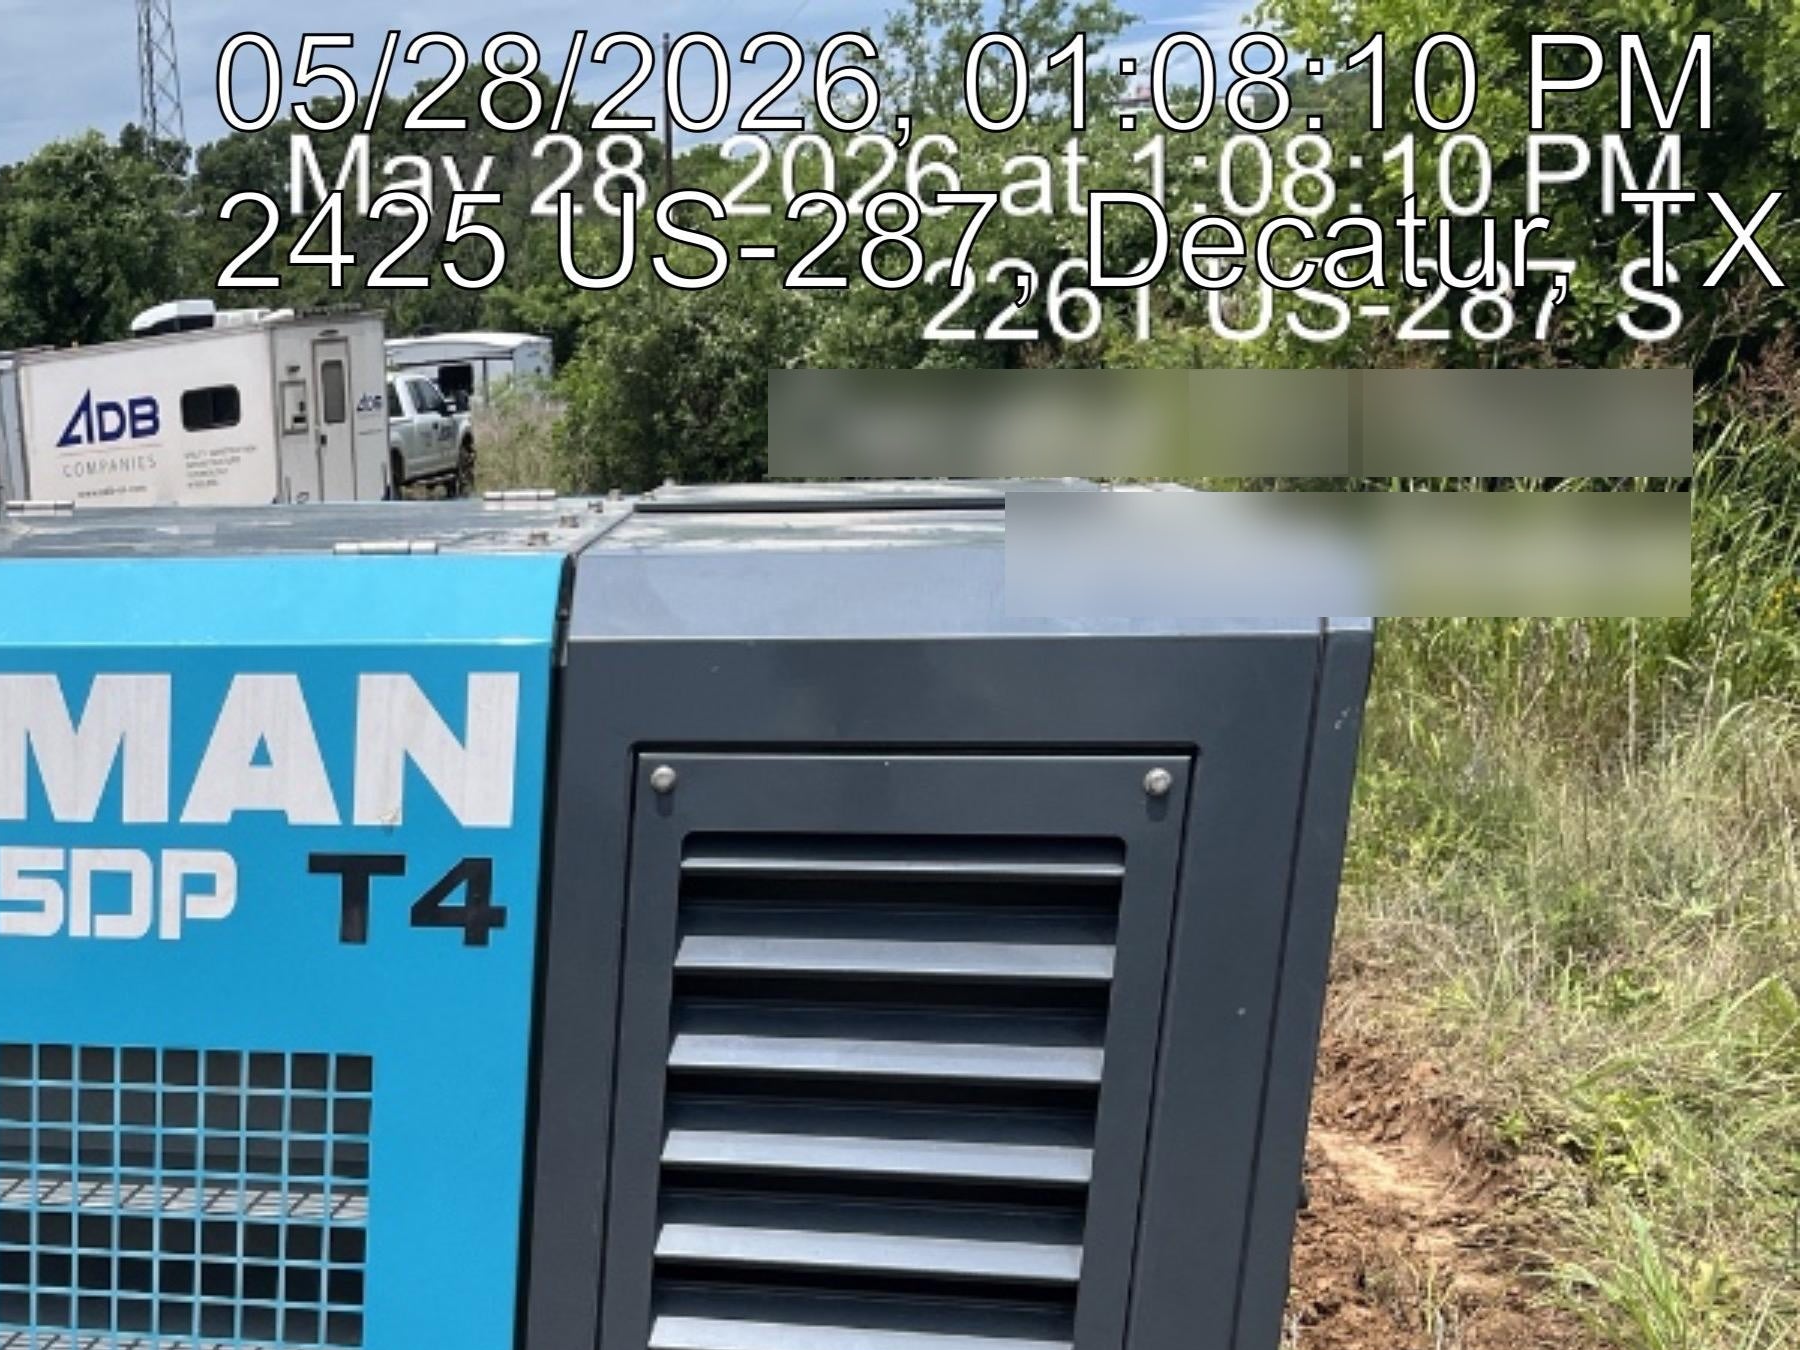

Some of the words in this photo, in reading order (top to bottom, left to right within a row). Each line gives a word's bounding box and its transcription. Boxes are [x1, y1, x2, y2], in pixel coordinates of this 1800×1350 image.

[56, 387, 160, 447] ADB
[62, 452, 157, 478] COMPANIES
[307, 853, 508, 947] T4
